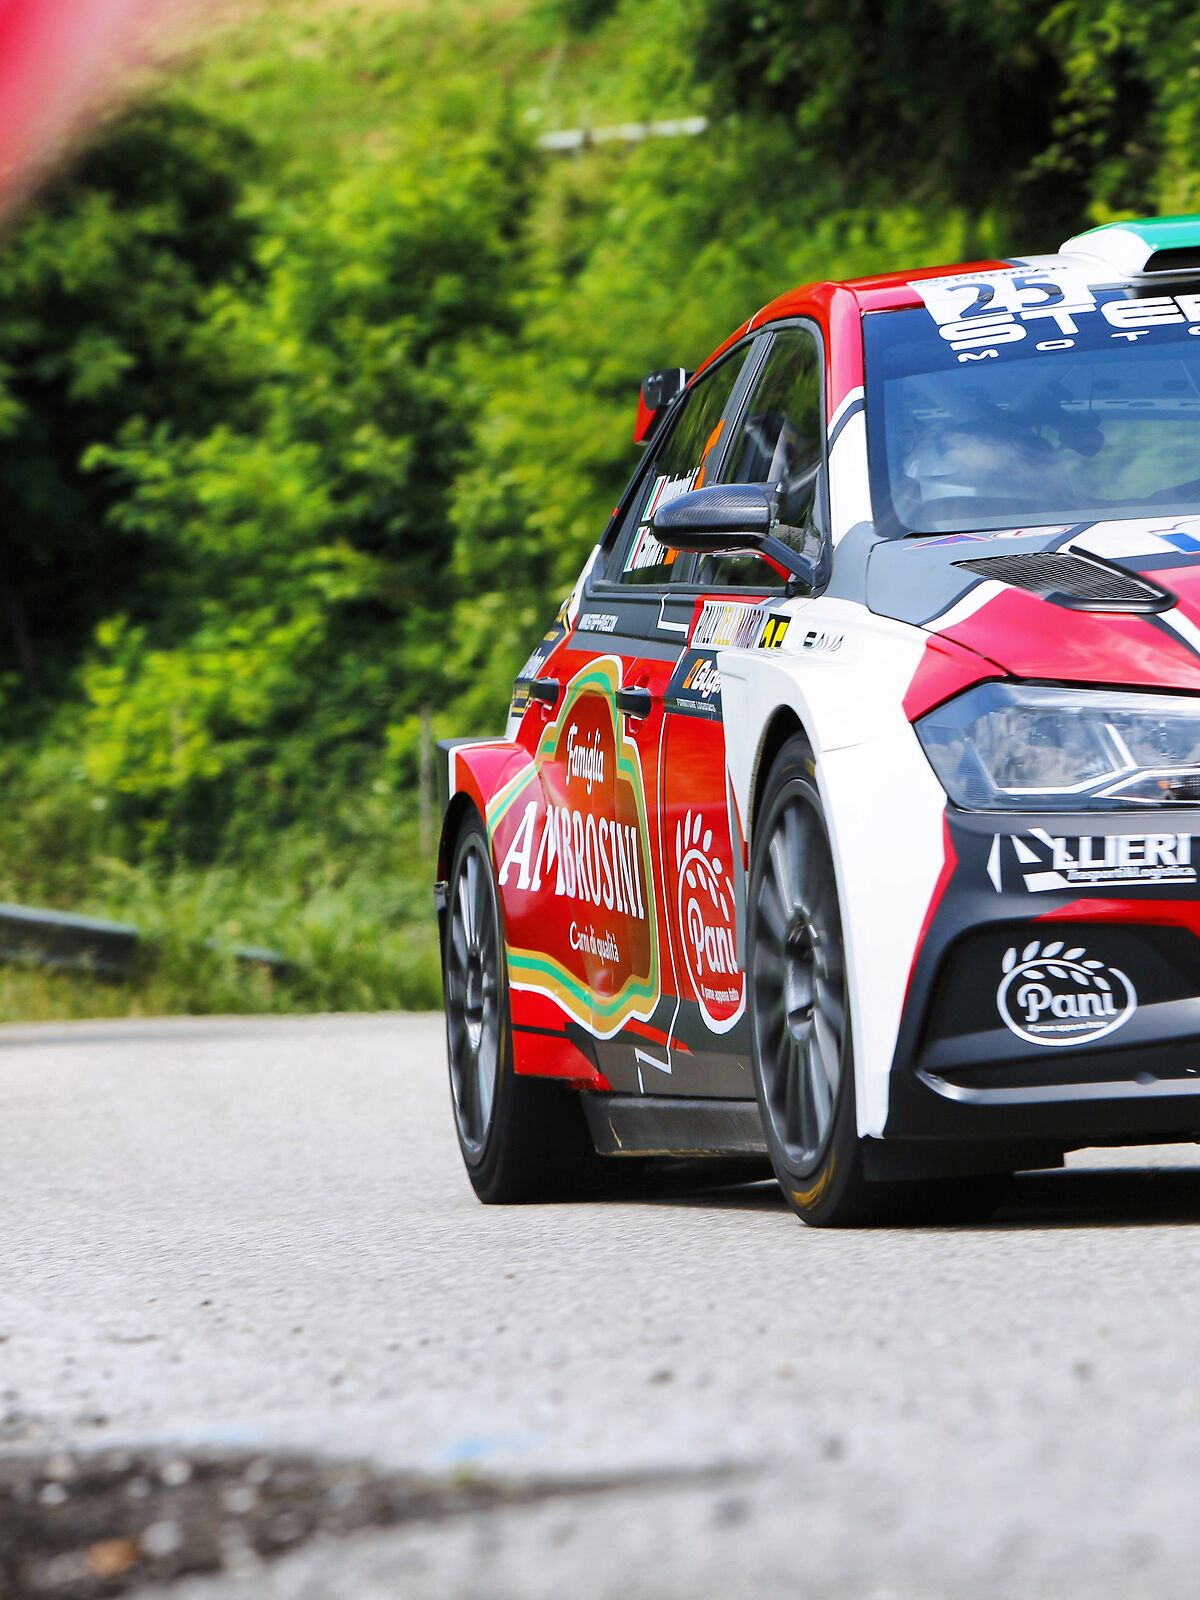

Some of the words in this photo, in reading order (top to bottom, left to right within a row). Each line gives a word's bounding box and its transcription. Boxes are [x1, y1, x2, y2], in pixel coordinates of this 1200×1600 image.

[945, 274, 1065, 318] 25
[565, 723, 605, 795] Famiglia
[498, 801, 645, 920] AMBROSINI
[687, 897, 738, 976] Pani
[1016, 983, 1118, 1022] Pani
